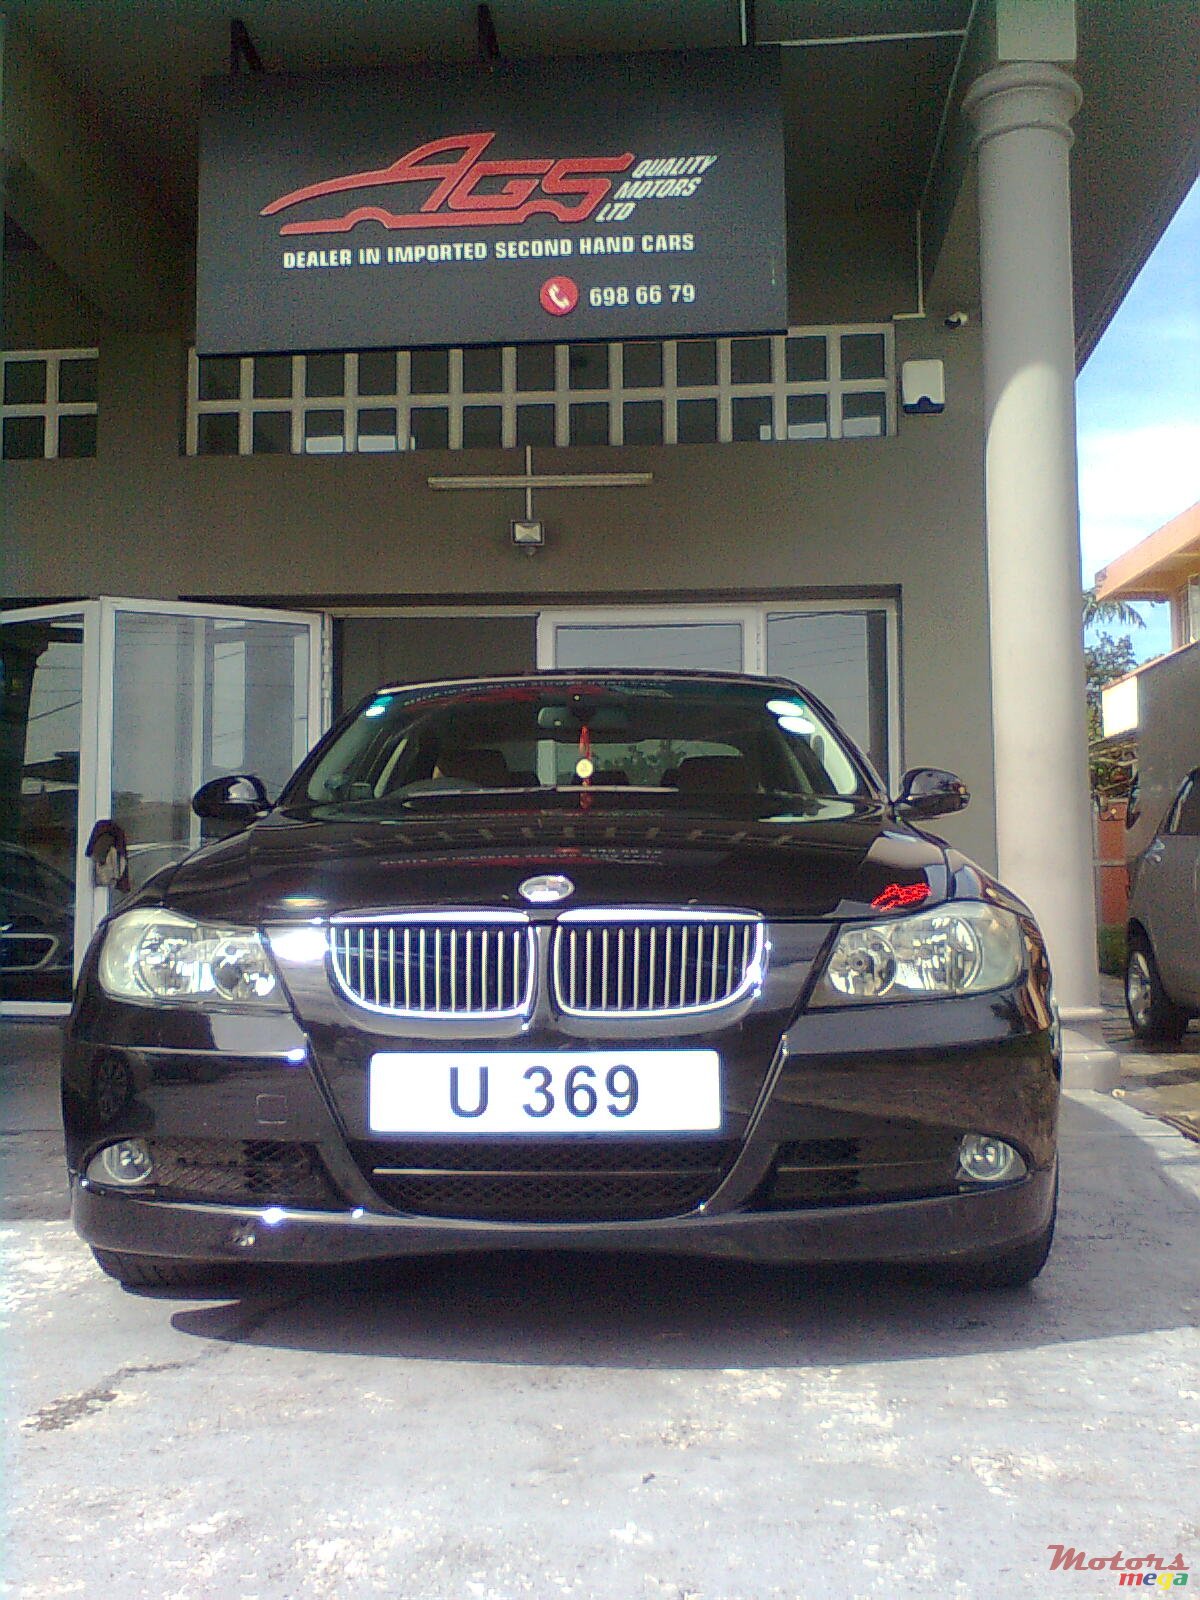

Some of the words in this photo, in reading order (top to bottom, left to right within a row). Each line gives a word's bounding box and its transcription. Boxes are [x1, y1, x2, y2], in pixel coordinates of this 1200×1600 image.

[631, 154, 718, 179] QUALITY
[259, 131, 635, 236] AGS
[613, 176, 702, 200] MOTORS
[595, 201, 637, 223] LTD
[283, 248, 352, 269] DEALER
[358, 246, 380, 266] IN
[387, 242, 487, 265] IMPORTED
[494, 237, 572, 260] SECOND
[579, 235, 635, 255] HAND
[641, 232, 694, 253] CARS
[588, 286, 630, 307] 698
[635, 284, 662, 305] 66
[668, 282, 696, 304] 79
[449, 1065, 489, 1118] U
[522, 1063, 639, 1119] 369
